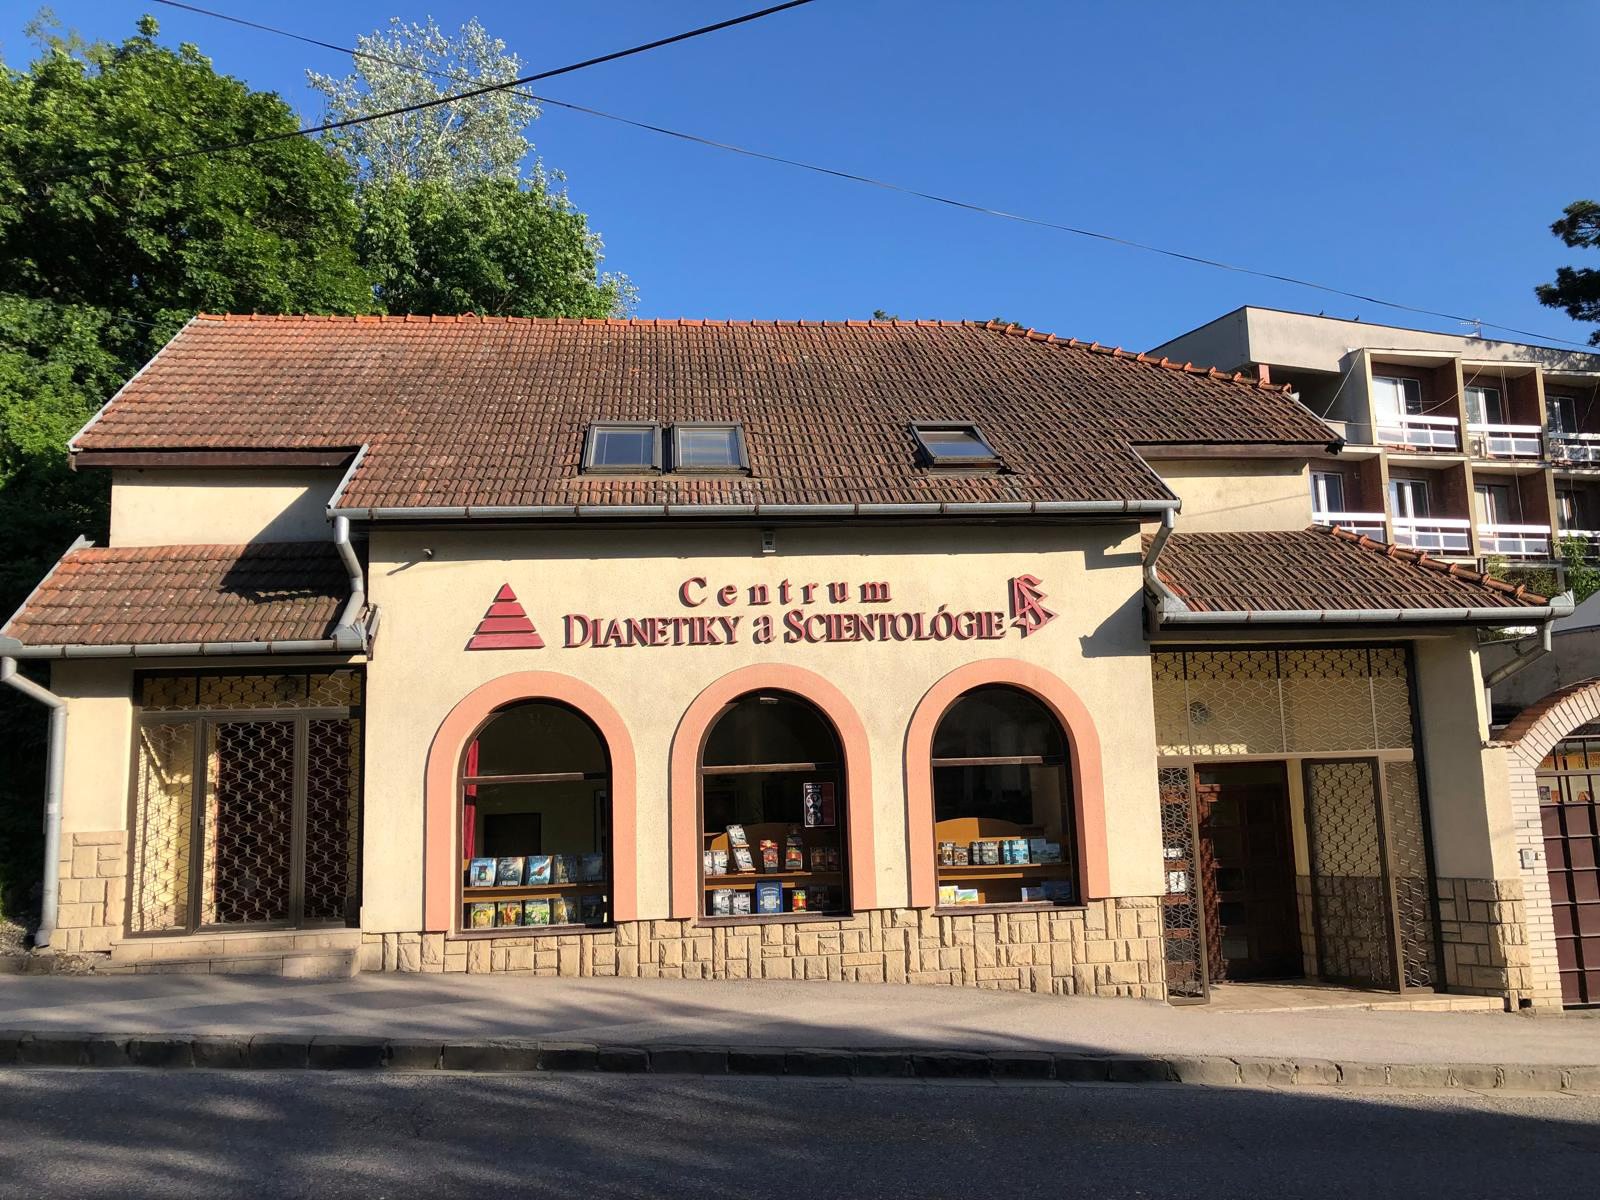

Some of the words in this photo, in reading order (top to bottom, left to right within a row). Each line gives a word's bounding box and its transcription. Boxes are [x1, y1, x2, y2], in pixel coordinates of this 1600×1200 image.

[678, 576, 892, 608] Centrum
[562, 613, 744, 648] DIANETIKY
[752, 613, 776, 645] a
[783, 604, 1006, 644] SCIENTOLÓGIE
